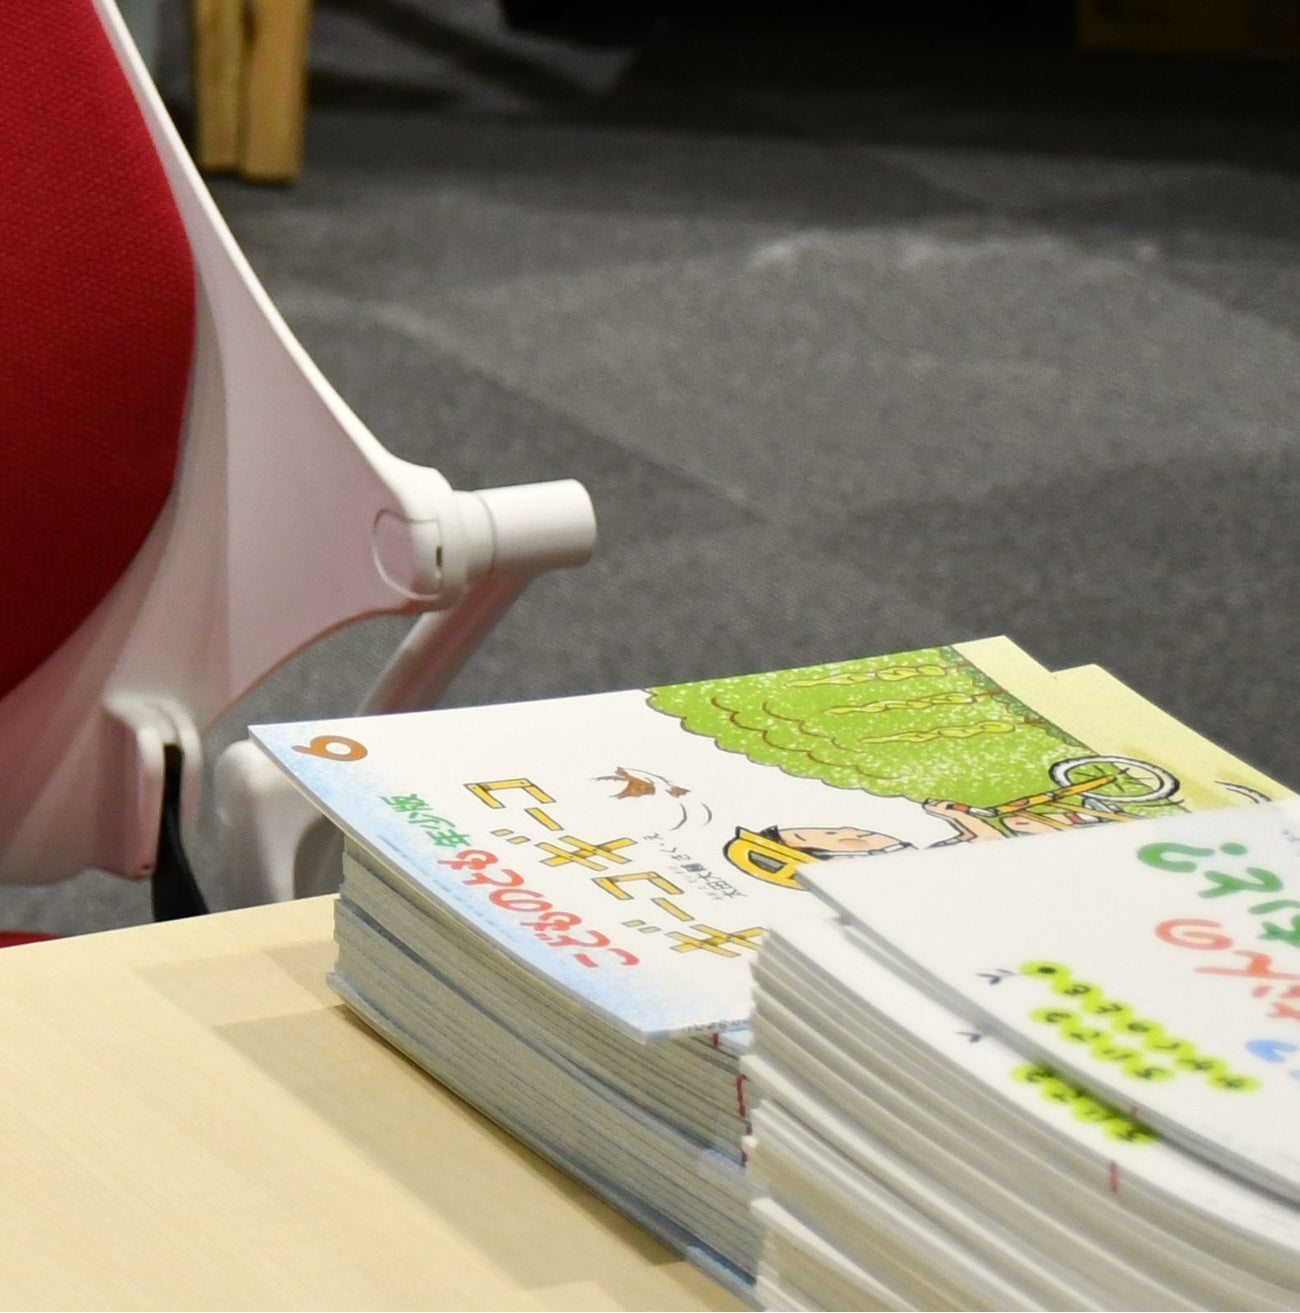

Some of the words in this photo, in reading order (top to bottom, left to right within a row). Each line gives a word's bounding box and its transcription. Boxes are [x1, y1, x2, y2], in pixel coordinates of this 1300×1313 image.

[379, 791, 473, 851] 年少版
[436, 848, 641, 969] こどものとも
